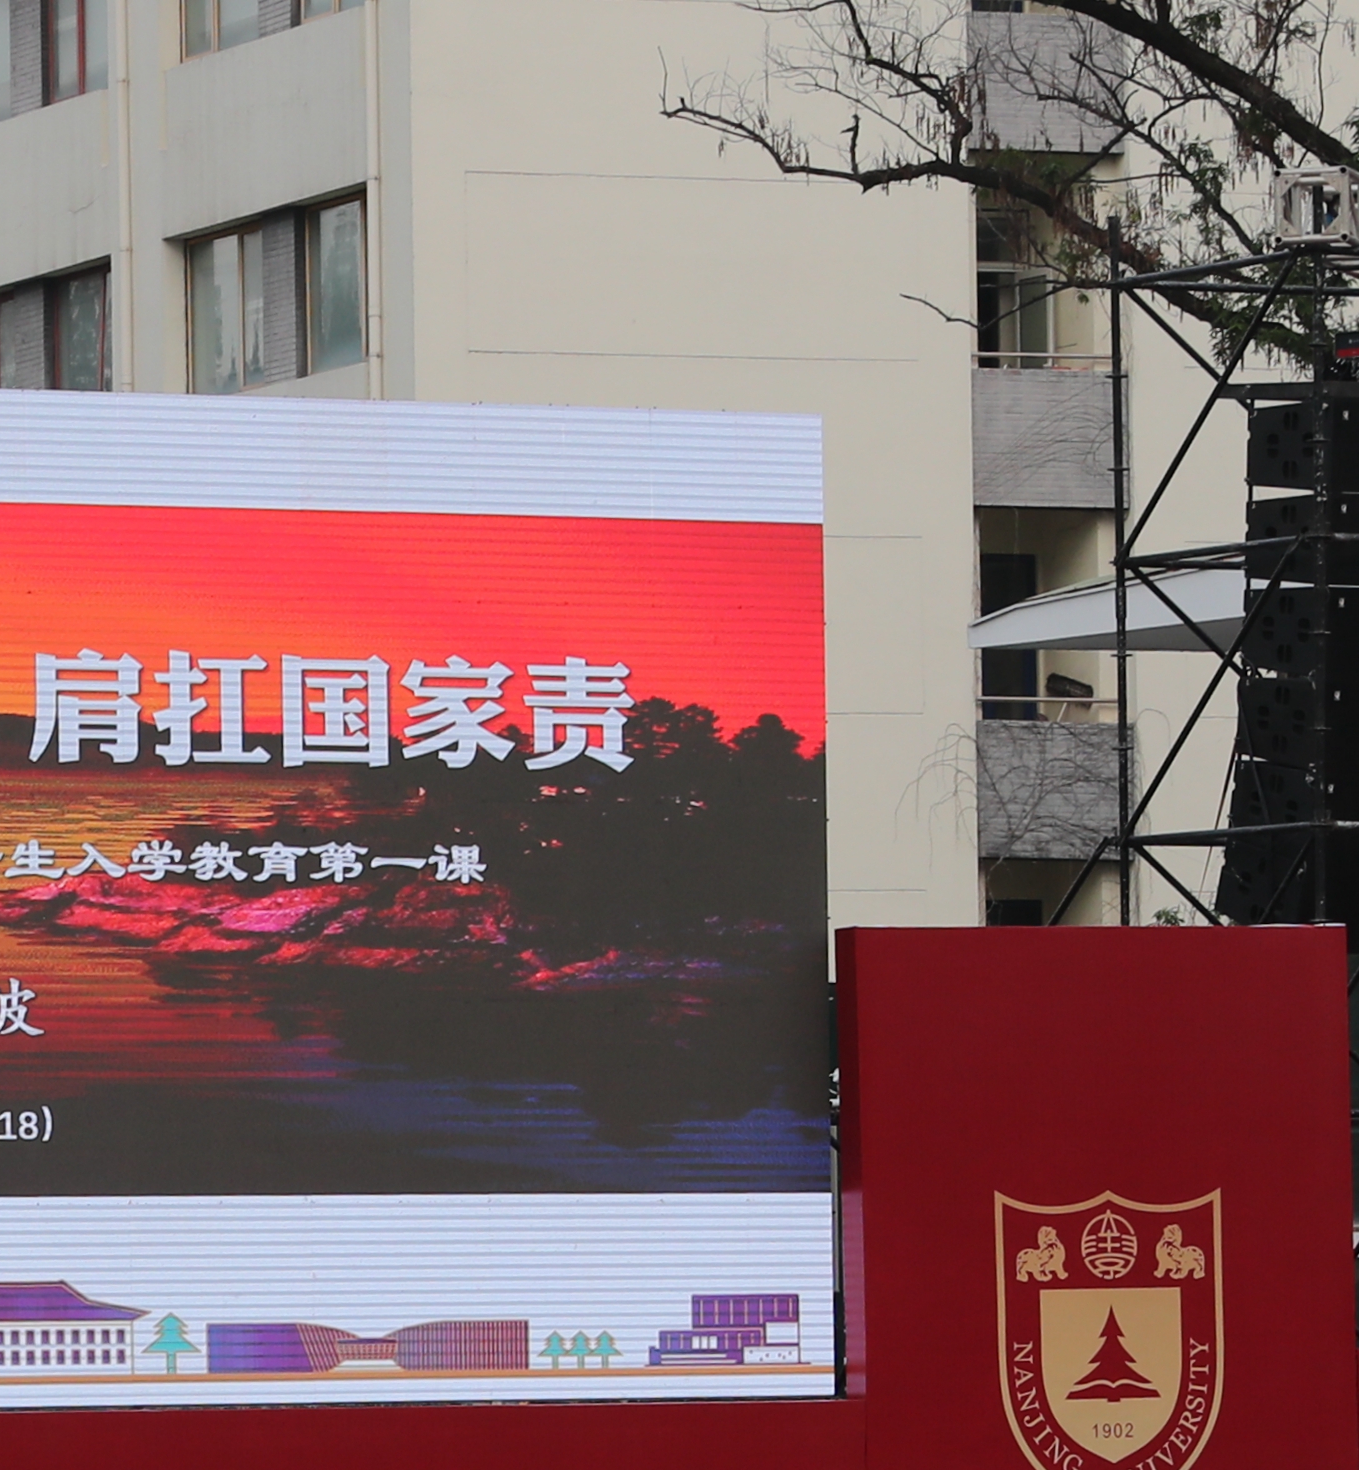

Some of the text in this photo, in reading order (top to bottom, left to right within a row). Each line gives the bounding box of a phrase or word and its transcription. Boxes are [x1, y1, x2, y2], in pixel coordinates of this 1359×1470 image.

[27, 647, 636, 774] 肩扛国家责
[1091, 1422, 1135, 1440] 1902
